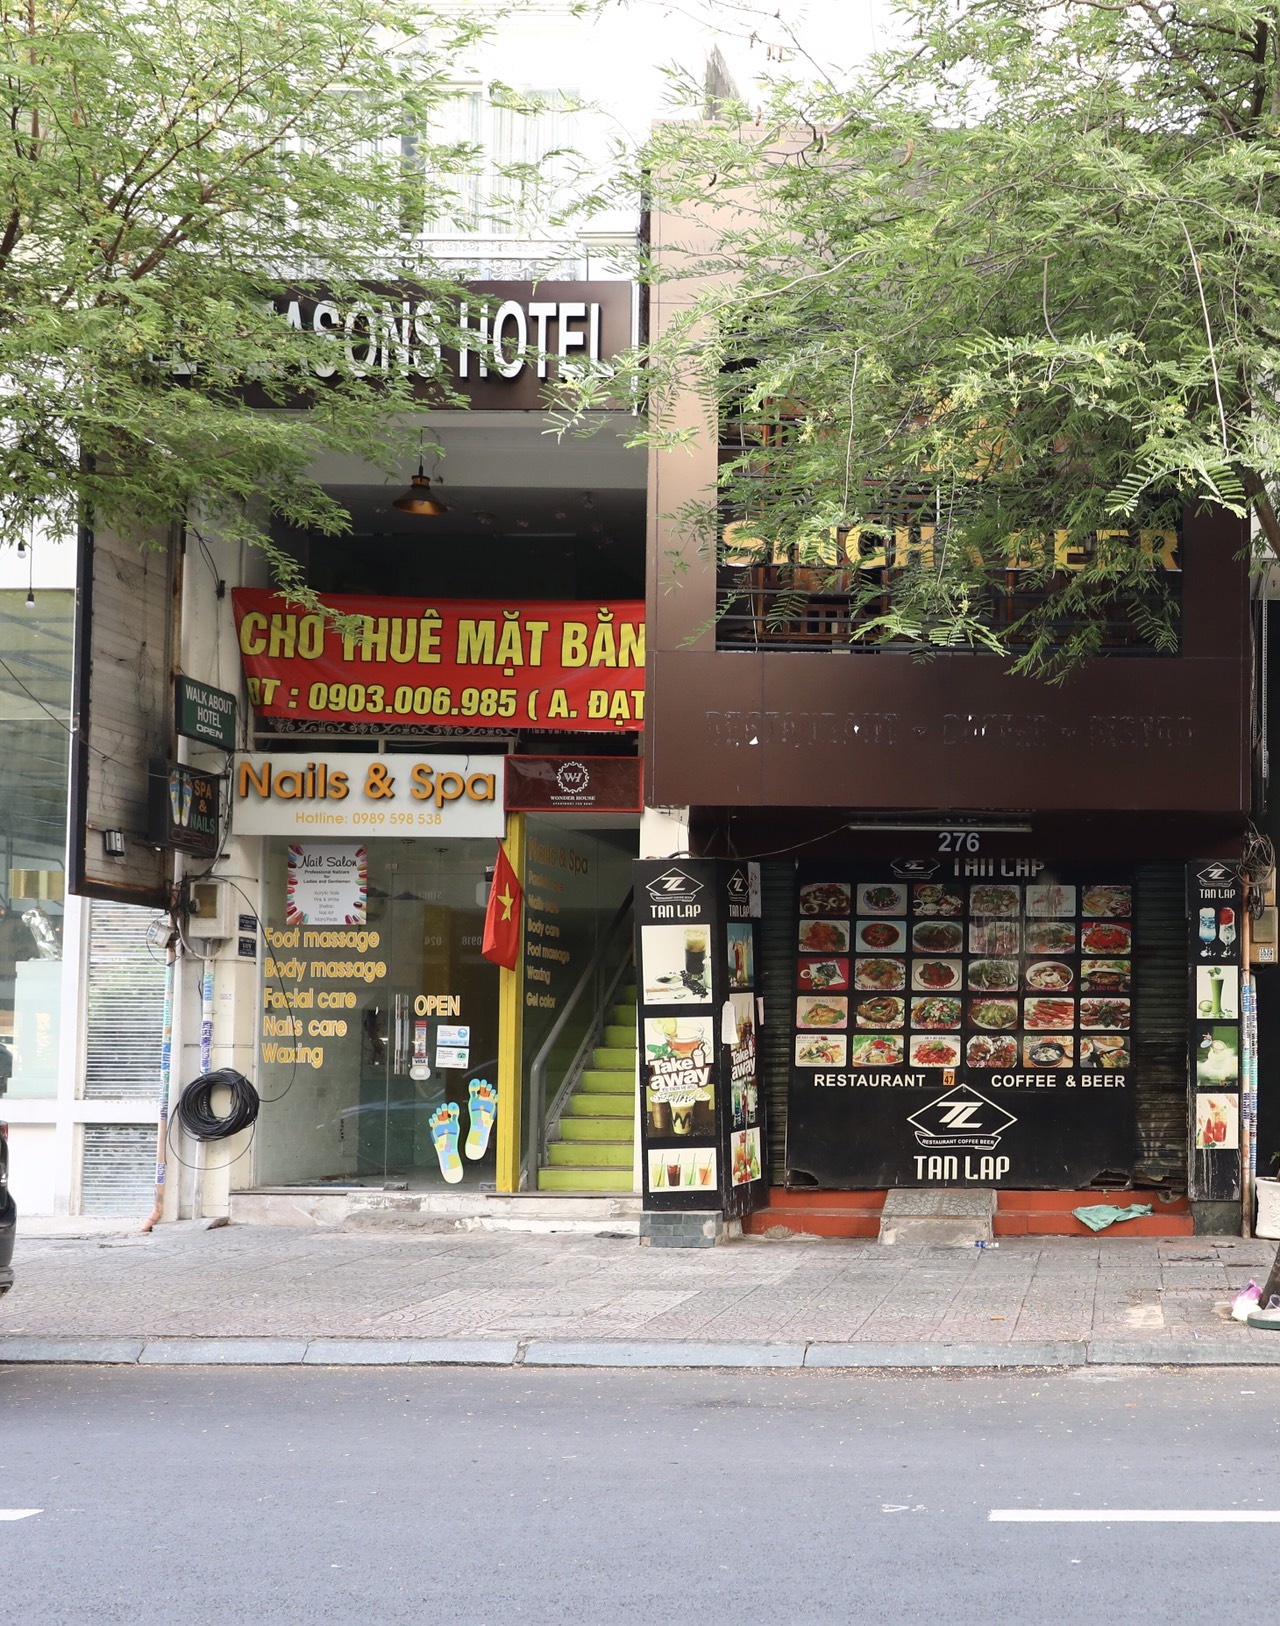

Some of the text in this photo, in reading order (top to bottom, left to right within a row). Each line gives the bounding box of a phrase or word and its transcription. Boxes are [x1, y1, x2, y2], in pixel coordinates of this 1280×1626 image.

[235, 300, 442, 378] ASONS
[459, 301, 614, 378] HOTEL
[722, 520, 1183, 571] SINGH BEER
[239, 607, 646, 677] CHO THUÊ MẶT BẰN
[185, 685, 233, 715] WALK ABOUT
[308, 682, 518, 717] 0903.006.985
[546, 689, 578, 719] A.
[587, 689, 646, 727] ĐẠT
[197, 707, 222, 728] HOTEL
[196, 724, 224, 739] OPEN
[194, 780, 212, 800] SPA
[238, 761, 497, 809] Nails & Spa
[199, 799, 207, 813] &
[190, 814, 216, 835] NAILS
[295, 811, 443, 825] Hotline: 0989 598 538
[938, 832, 980, 852] 276
[298, 855, 358, 869] Nail Salon
[569, 849, 589, 876] Spa
[1199, 889, 1236, 899] TAN LAP
[650, 904, 701, 918] TAN LAP
[729, 904, 739, 917] TAN
[527, 917, 545, 938] Body
[264, 927, 301, 948] Foot
[303, 930, 380, 953] massage
[527, 941, 542, 958] Foot
[264, 957, 387, 983] Body massage
[527, 965, 551, 985] Waxing
[263, 987, 357, 1009] Facial care
[414, 994, 461, 1017] OPEN
[526, 991, 556, 1009] Gel color
[262, 1015, 348, 1037] Nails care
[261, 1042, 324, 1069] Waxing
[650, 1056, 694, 1075] Take
[731, 1048, 750, 1066] Take
[651, 1067, 710, 1091] away
[731, 1056, 756, 1081] away
[813, 1074, 926, 1087] RESTAURANT
[944, 1075, 954, 1085] 47
[991, 1075, 1126, 1088] COFFEE & BEER
[979, 1138, 995, 1146] BEER
[913, 1155, 1010, 1180] TAN LAP
